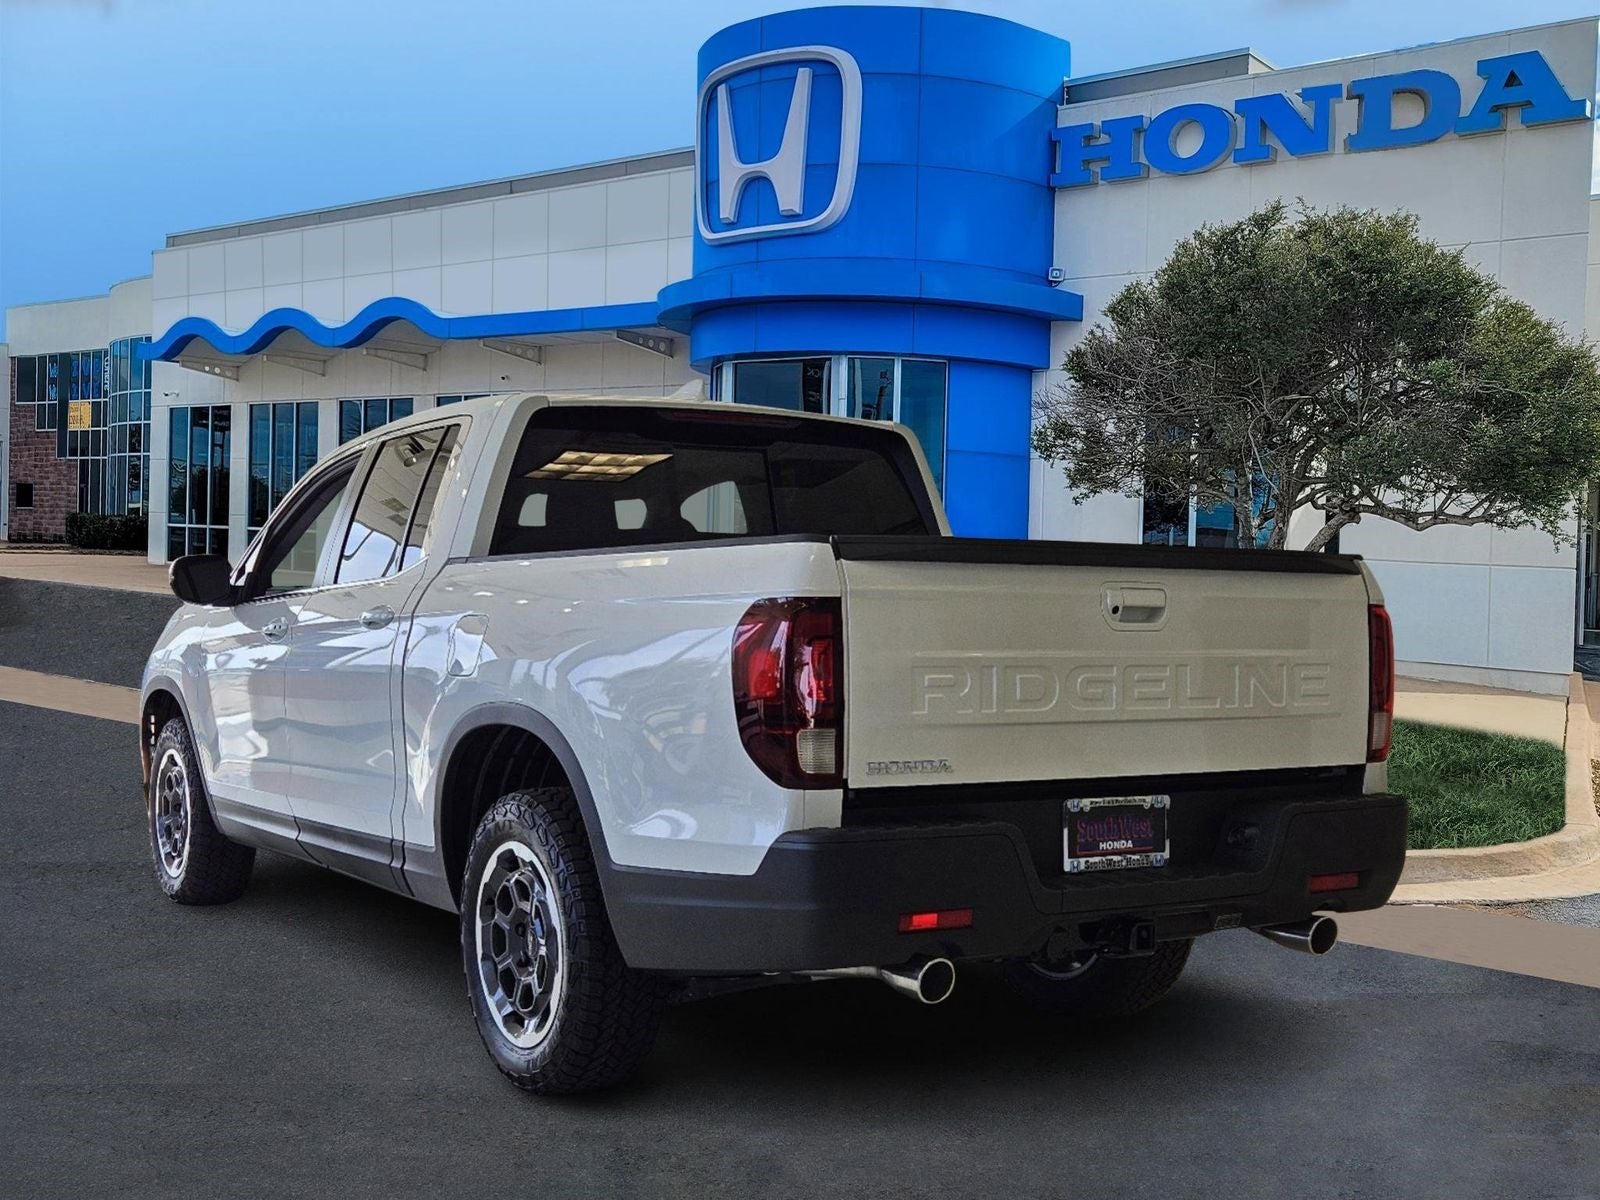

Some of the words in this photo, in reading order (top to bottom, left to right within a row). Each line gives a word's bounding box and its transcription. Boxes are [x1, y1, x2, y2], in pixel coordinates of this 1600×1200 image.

[1050, 50, 1592, 188] HONDA
[911, 663, 1331, 715] RIDGELINE
[865, 759, 954, 775] HONDA
[1099, 840, 1133, 850] HONDA
